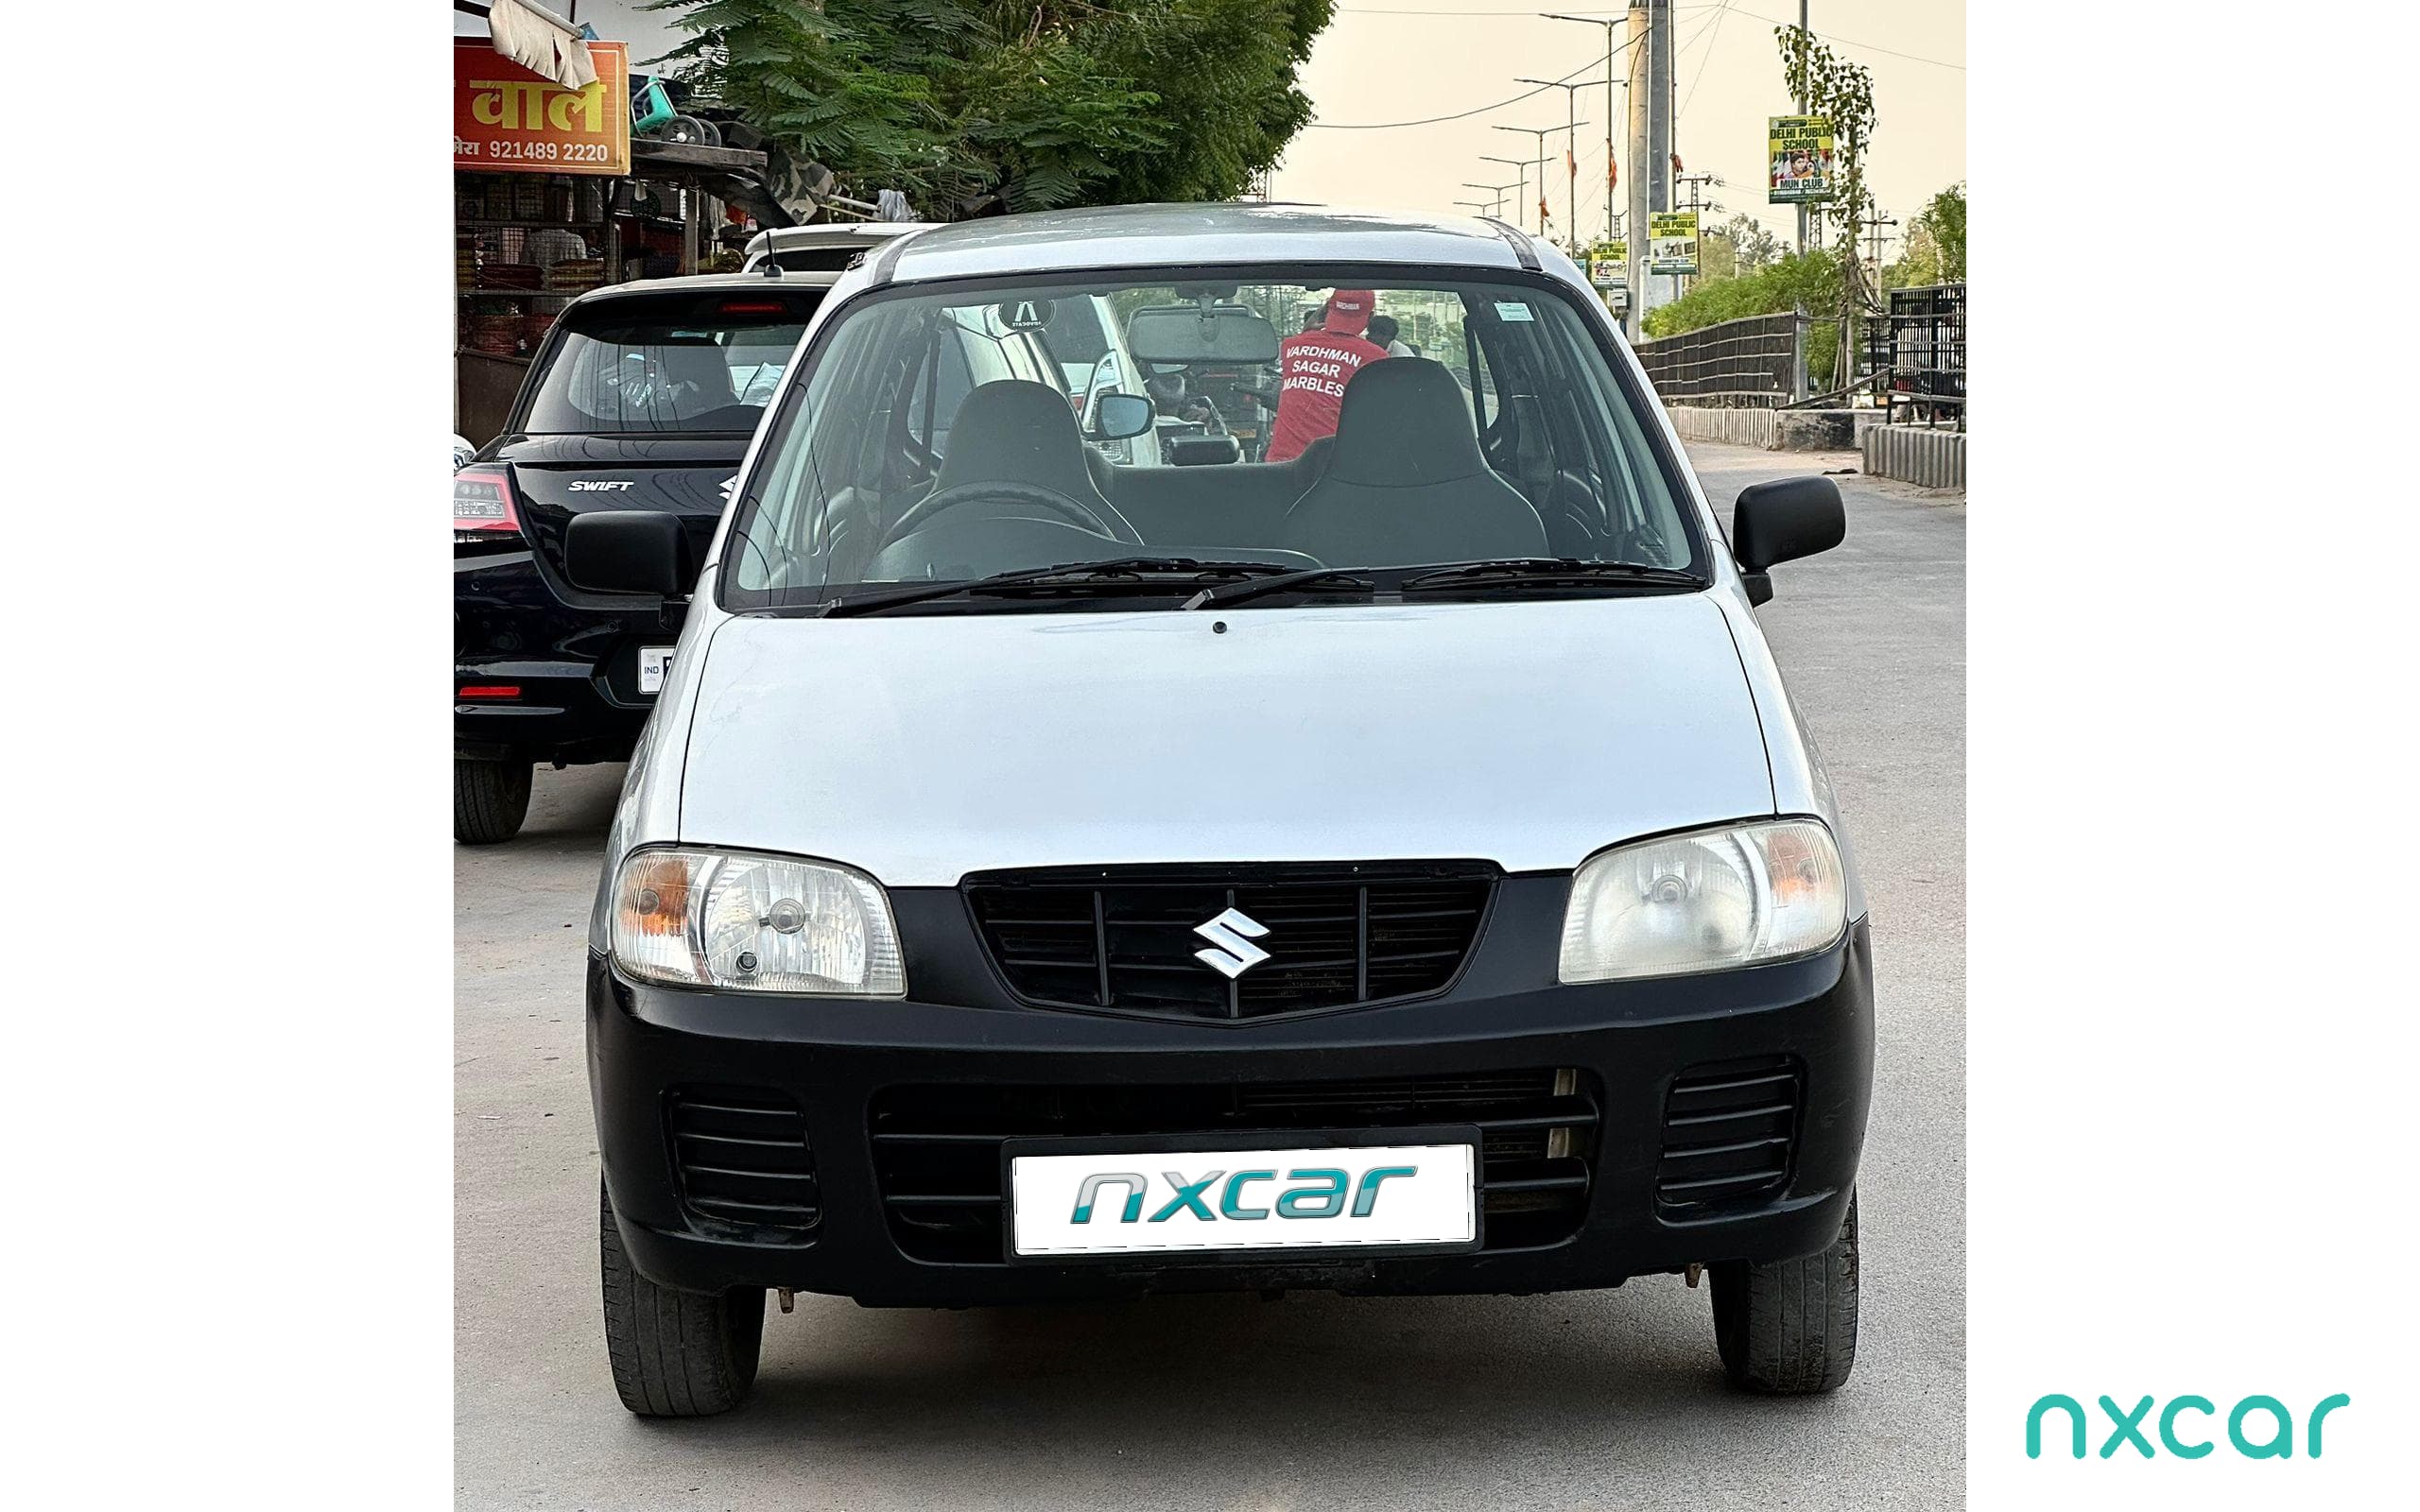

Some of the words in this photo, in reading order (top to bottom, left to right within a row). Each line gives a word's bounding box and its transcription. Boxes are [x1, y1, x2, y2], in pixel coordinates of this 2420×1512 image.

[469, 77, 608, 133] वाल
[1770, 128, 1796, 140] DELHI
[1799, 125, 1834, 138] PUBLIC
[1782, 138, 1820, 150] SCHOOL
[490, 141, 558, 160] 921489
[562, 143, 608, 162] 2220
[1780, 179, 1800, 190] MUN
[1802, 178, 1824, 188] CLUB
[1651, 220, 1670, 229] DELHI
[1671, 219, 1696, 228] PUBLIC
[1660, 228, 1687, 237] SCHOOL
[1287, 346, 1361, 367] VARDHMAN
[1292, 360, 1340, 378] SAGAR
[1283, 376, 1344, 397] MARBLES
[567, 480, 635, 491] SWIFT
[644, 665, 660, 675] IND
